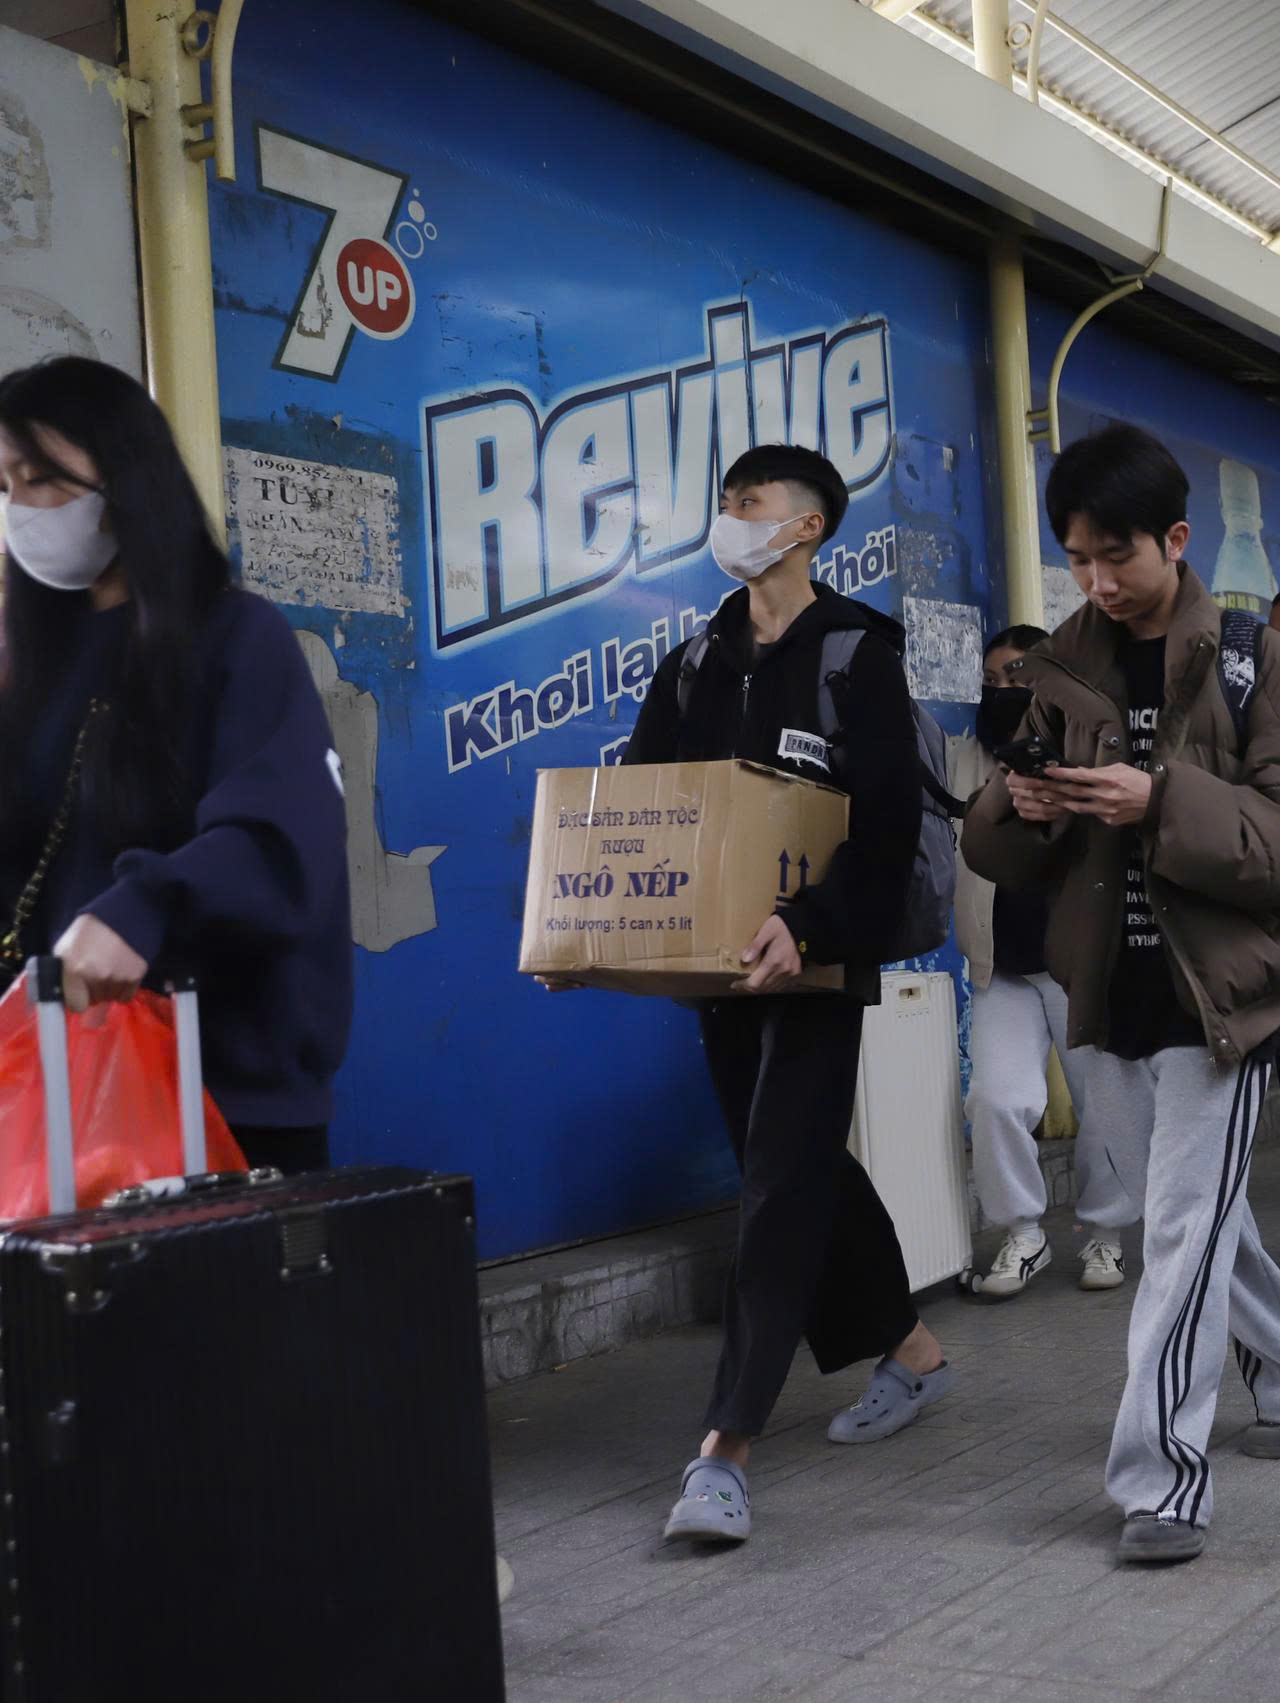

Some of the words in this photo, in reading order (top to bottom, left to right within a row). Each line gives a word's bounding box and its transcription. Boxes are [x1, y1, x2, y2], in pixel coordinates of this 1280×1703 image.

[254, 121, 410, 384] 7
[347, 261, 402, 312] UP
[425, 302, 890, 650] Revive
[444, 649, 593, 774] Khơi
[552, 864, 614, 899] NGÔ
[624, 858, 689, 898] NẾP
[619, 916, 626, 930] 5
[630, 919, 653, 930] can
[656, 919, 664, 930] x
[668, 916, 676, 930] 5
